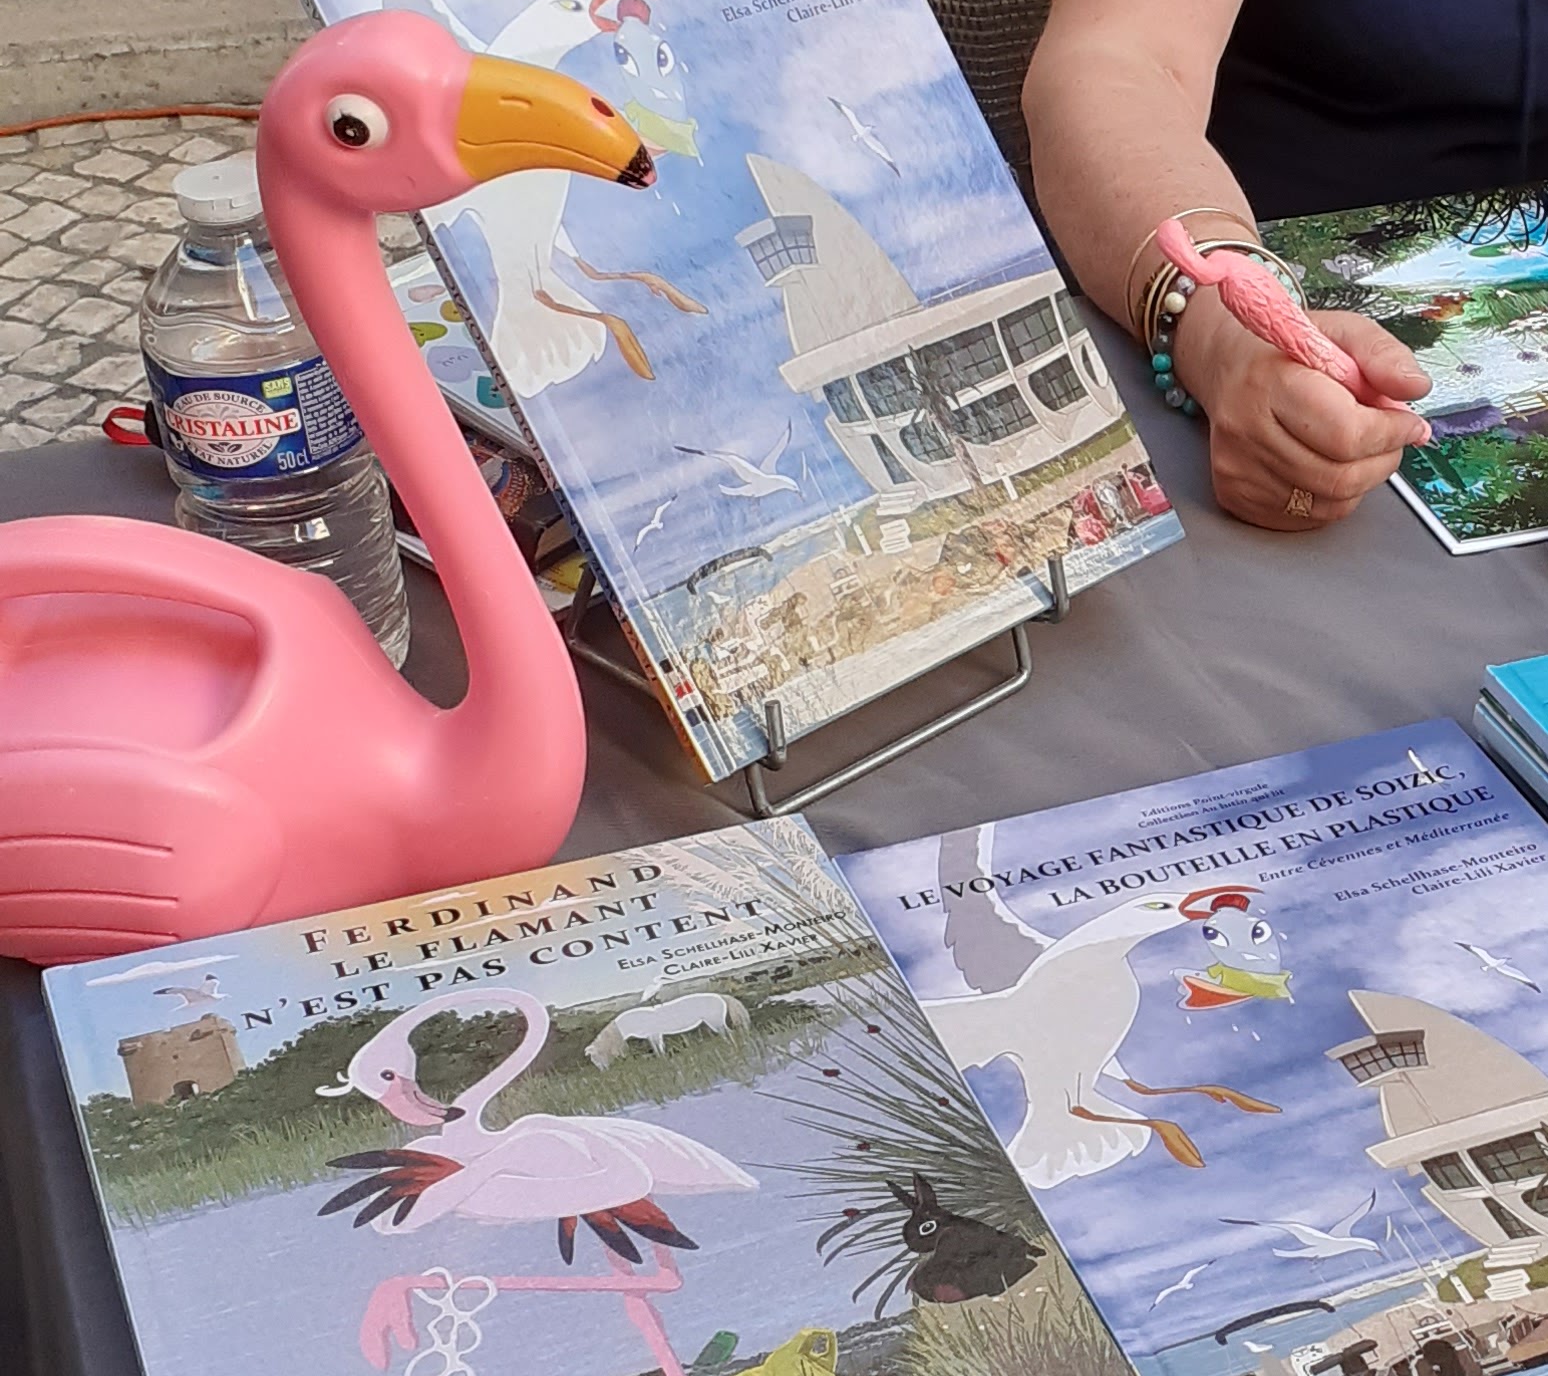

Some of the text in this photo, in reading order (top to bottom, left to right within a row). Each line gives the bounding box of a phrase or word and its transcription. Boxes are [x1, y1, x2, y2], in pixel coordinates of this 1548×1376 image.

[721, 5, 752, 24] Elsa
[167, 410, 298, 439] CRISTALINE
[194, 392, 265, 414] DE SOURCE
[217, 441, 274, 467] NATUREL
[897, 764, 1466, 912] LE VOYAGE FANTASTIQUE DE SOIZIC,
[1047, 785, 1496, 908] LA BOUTEILLE EN PLASTIQUE
[300, 863, 664, 955] FERDINAND
[331, 892, 660, 979] LE FLAMANT
[241, 898, 762, 1031] N'EST PAS CONTENT
